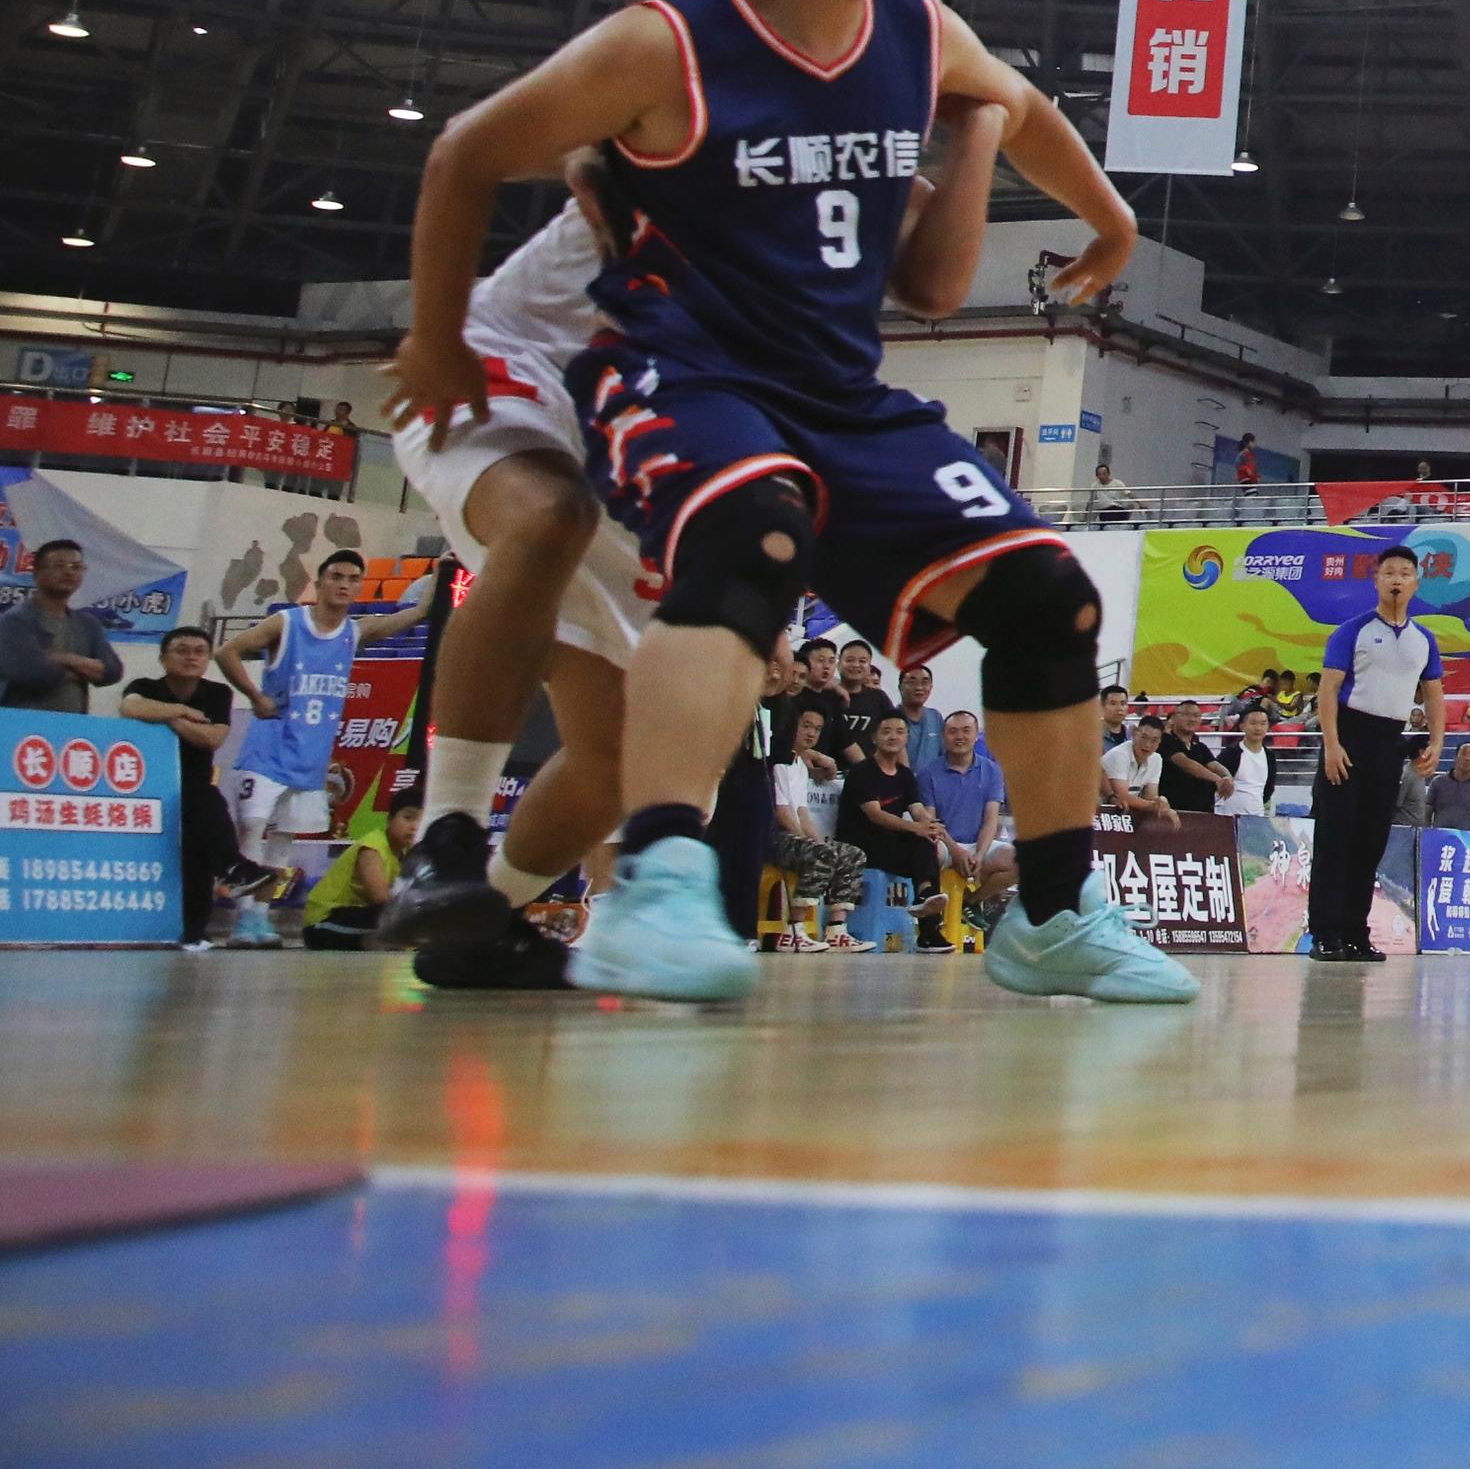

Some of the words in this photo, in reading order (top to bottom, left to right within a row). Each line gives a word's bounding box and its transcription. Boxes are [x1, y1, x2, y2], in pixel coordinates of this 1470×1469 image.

[734, 130, 920, 187] 长顺农信
[815, 190, 862, 269] 9
[6, 406, 39, 430] 罪
[86, 412, 336, 461] 维护社会平安稳定
[933, 460, 1012, 519] 9
[290, 673, 349, 698] LAKERS
[305, 699, 322, 725] 8
[337, 717, 413, 748] 易购
[23, 742, 139, 783] 长顺店
[9, 798, 153, 828] 鸡汤生蚝烙锅
[22, 856, 164, 882] 18985445869
[22, 888, 167, 913] 17885246449
